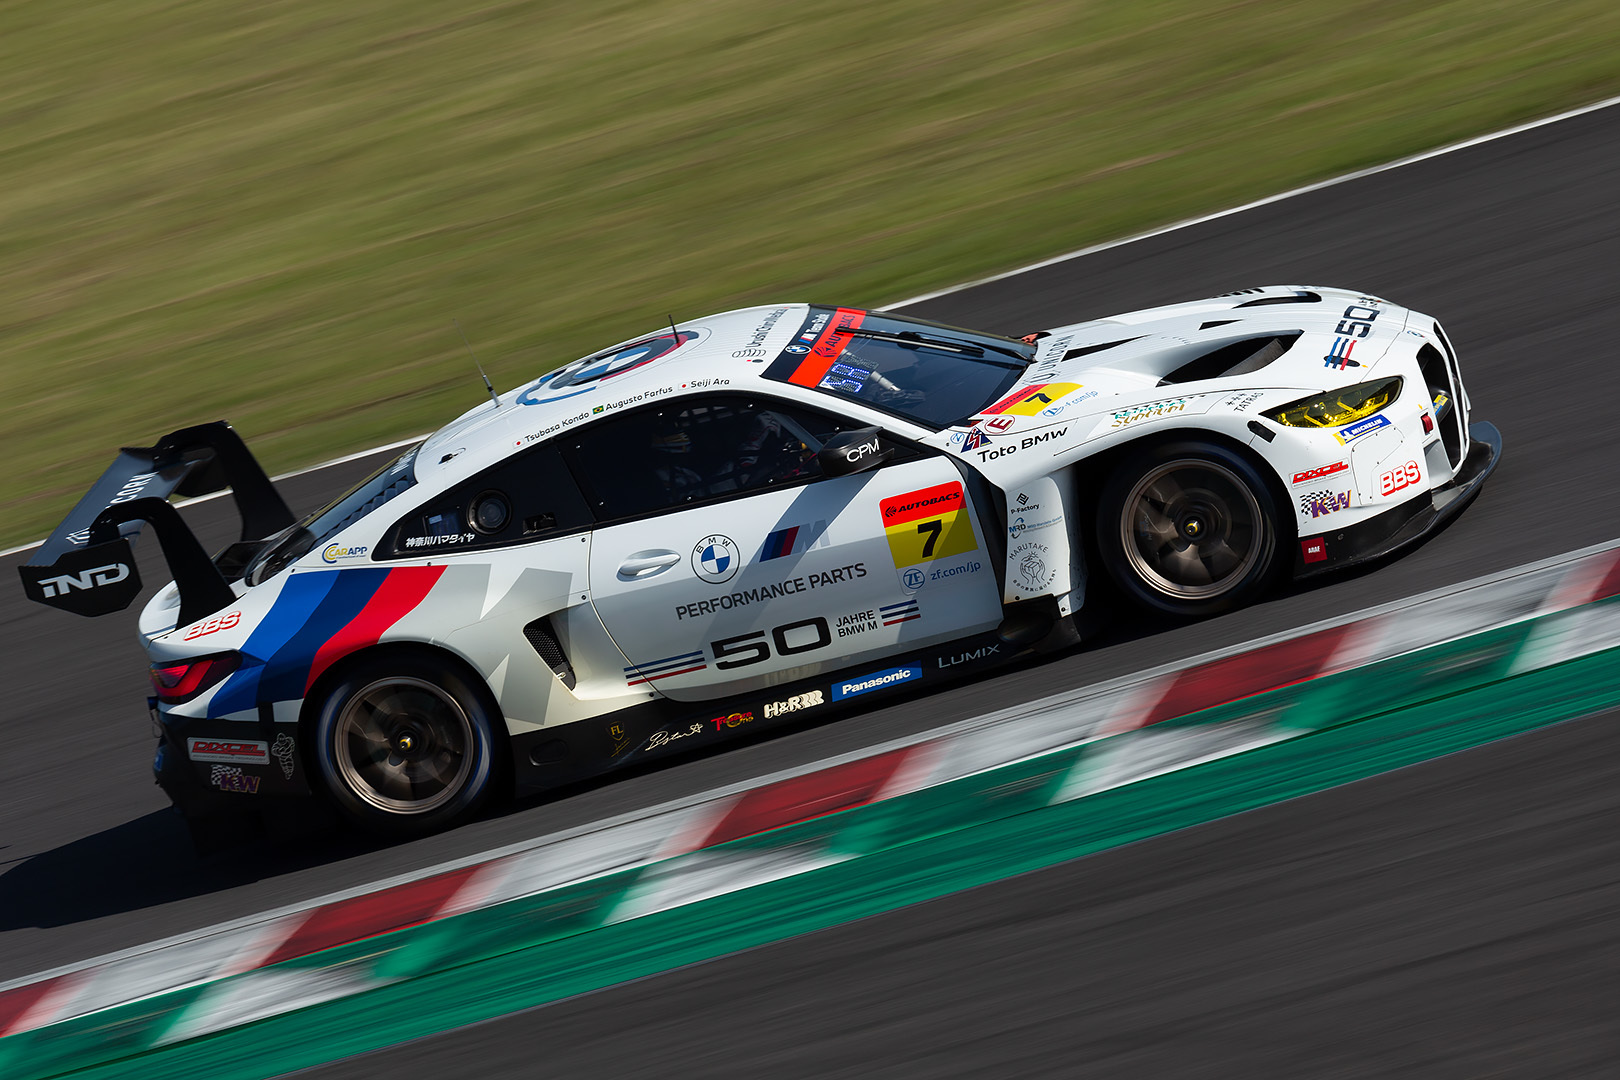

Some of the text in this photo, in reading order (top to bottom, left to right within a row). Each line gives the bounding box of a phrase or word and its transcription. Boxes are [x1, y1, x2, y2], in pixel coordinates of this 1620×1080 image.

[825, 314, 856, 348] AUTBACS
[1334, 305, 1380, 338] 50
[1023, 392, 1052, 404] 7
[524, 377, 730, 443] Tsubasa Kondo Augusto Farfus Seiji Ara
[1351, 418, 1383, 434] MICHELIN
[846, 438, 880, 462] CPM
[977, 427, 1068, 463] Toto BMW
[1292, 461, 1349, 484] DIXCEL
[1379, 460, 1421, 497] BBS
[897, 491, 961, 513] AUTOBACS
[1010, 503, 1040, 514] P-Factory
[1311, 489, 1352, 518] KW
[917, 518, 943, 558] 7
[1008, 523, 1026, 533] MRD
[405, 532, 476, 548] 神奈川ハマタイヤ
[695, 536, 732, 554] BMW
[1008, 542, 1049, 560] MARUTAKE
[930, 560, 982, 581] zf.com/jp
[675, 562, 868, 620] PERFORMANCE PARTS
[183, 610, 242, 641] BBS
[835, 609, 876, 628] JAHRE
[837, 621, 878, 638] BMW M
[710, 616, 832, 670] 50
[938, 643, 1001, 669] LUMIX
[842, 668, 912, 695] Panasonic
[610, 725, 624, 736] FL
[192, 741, 266, 756] DIXCEL
[220, 772, 260, 794] KW
